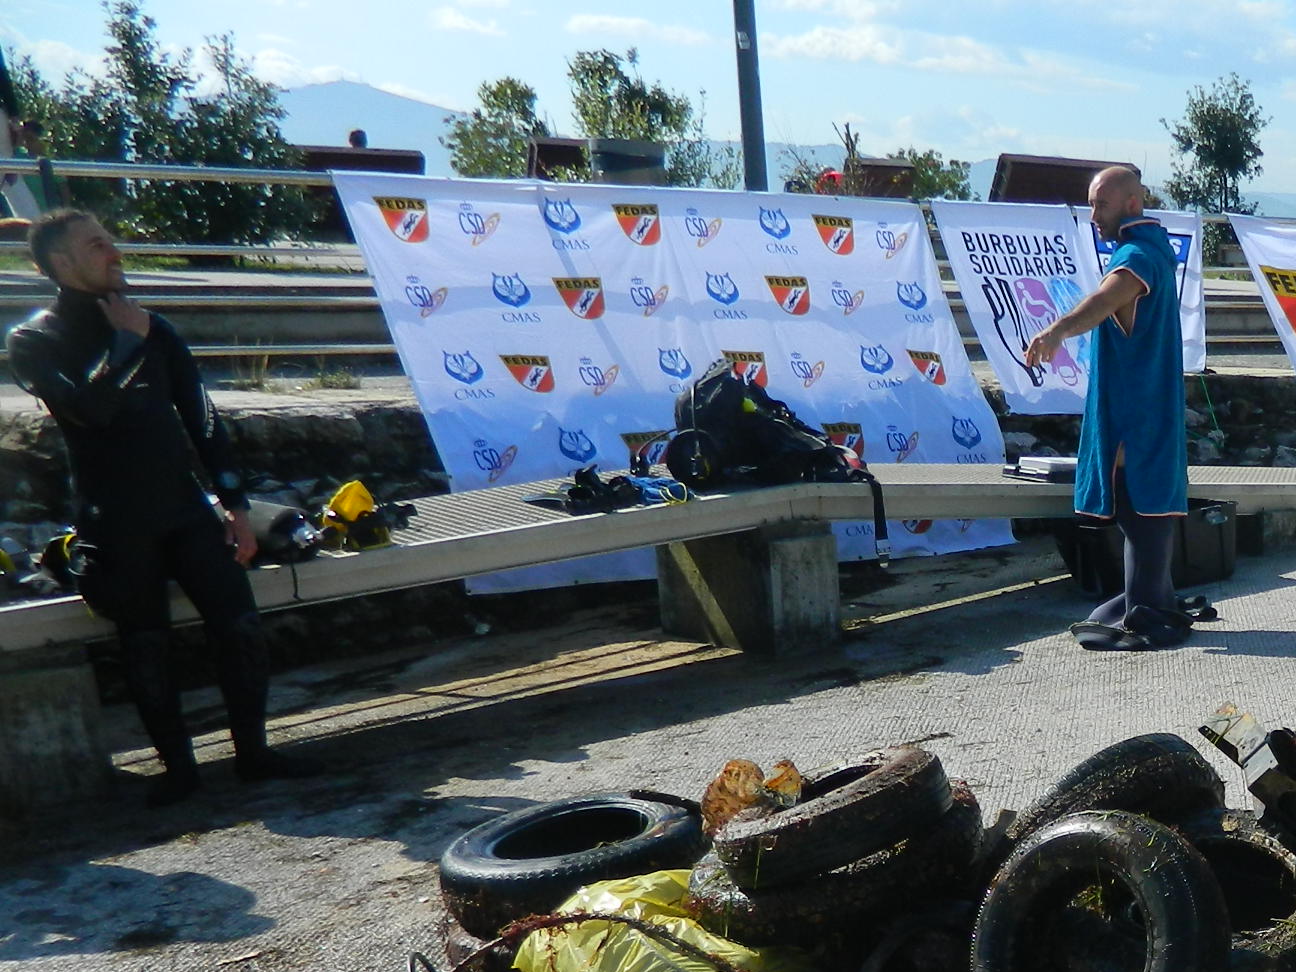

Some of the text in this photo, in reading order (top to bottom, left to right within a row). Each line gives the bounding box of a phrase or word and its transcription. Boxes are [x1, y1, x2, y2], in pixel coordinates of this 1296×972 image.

[377, 198, 425, 211] FEDAS
[615, 206, 657, 216] FEDAS
[459, 213, 485, 235] CSD
[685, 217, 708, 237] CSD
[815, 216, 851, 228] FEDAS
[552, 239, 590, 249] CMAS
[876, 231, 895, 250] CSD
[962, 232, 1067, 255] BURBUJAS
[766, 243, 799, 255] CMAS
[970, 254, 1077, 276] SOLIDARIAS
[556, 279, 602, 289] FEDAS
[767, 277, 807, 287] FEDAS
[405, 286, 432, 308] CSD
[630, 287, 656, 306] CSD
[832, 289, 853, 307] CSD
[502, 312, 541, 323] CMAS
[714, 309, 748, 320] CMAS
[904, 314, 935, 323] CMAS
[503, 356, 548, 366] FEDAS
[579, 367, 605, 386] CSD
[791, 362, 812, 379] CSD
[869, 377, 903, 390] CMAS
[454, 388, 495, 401] CMAS
[886, 432, 908, 452] CSD
[473, 448, 501, 471] CSD
[846, 524, 874, 537] CMA
